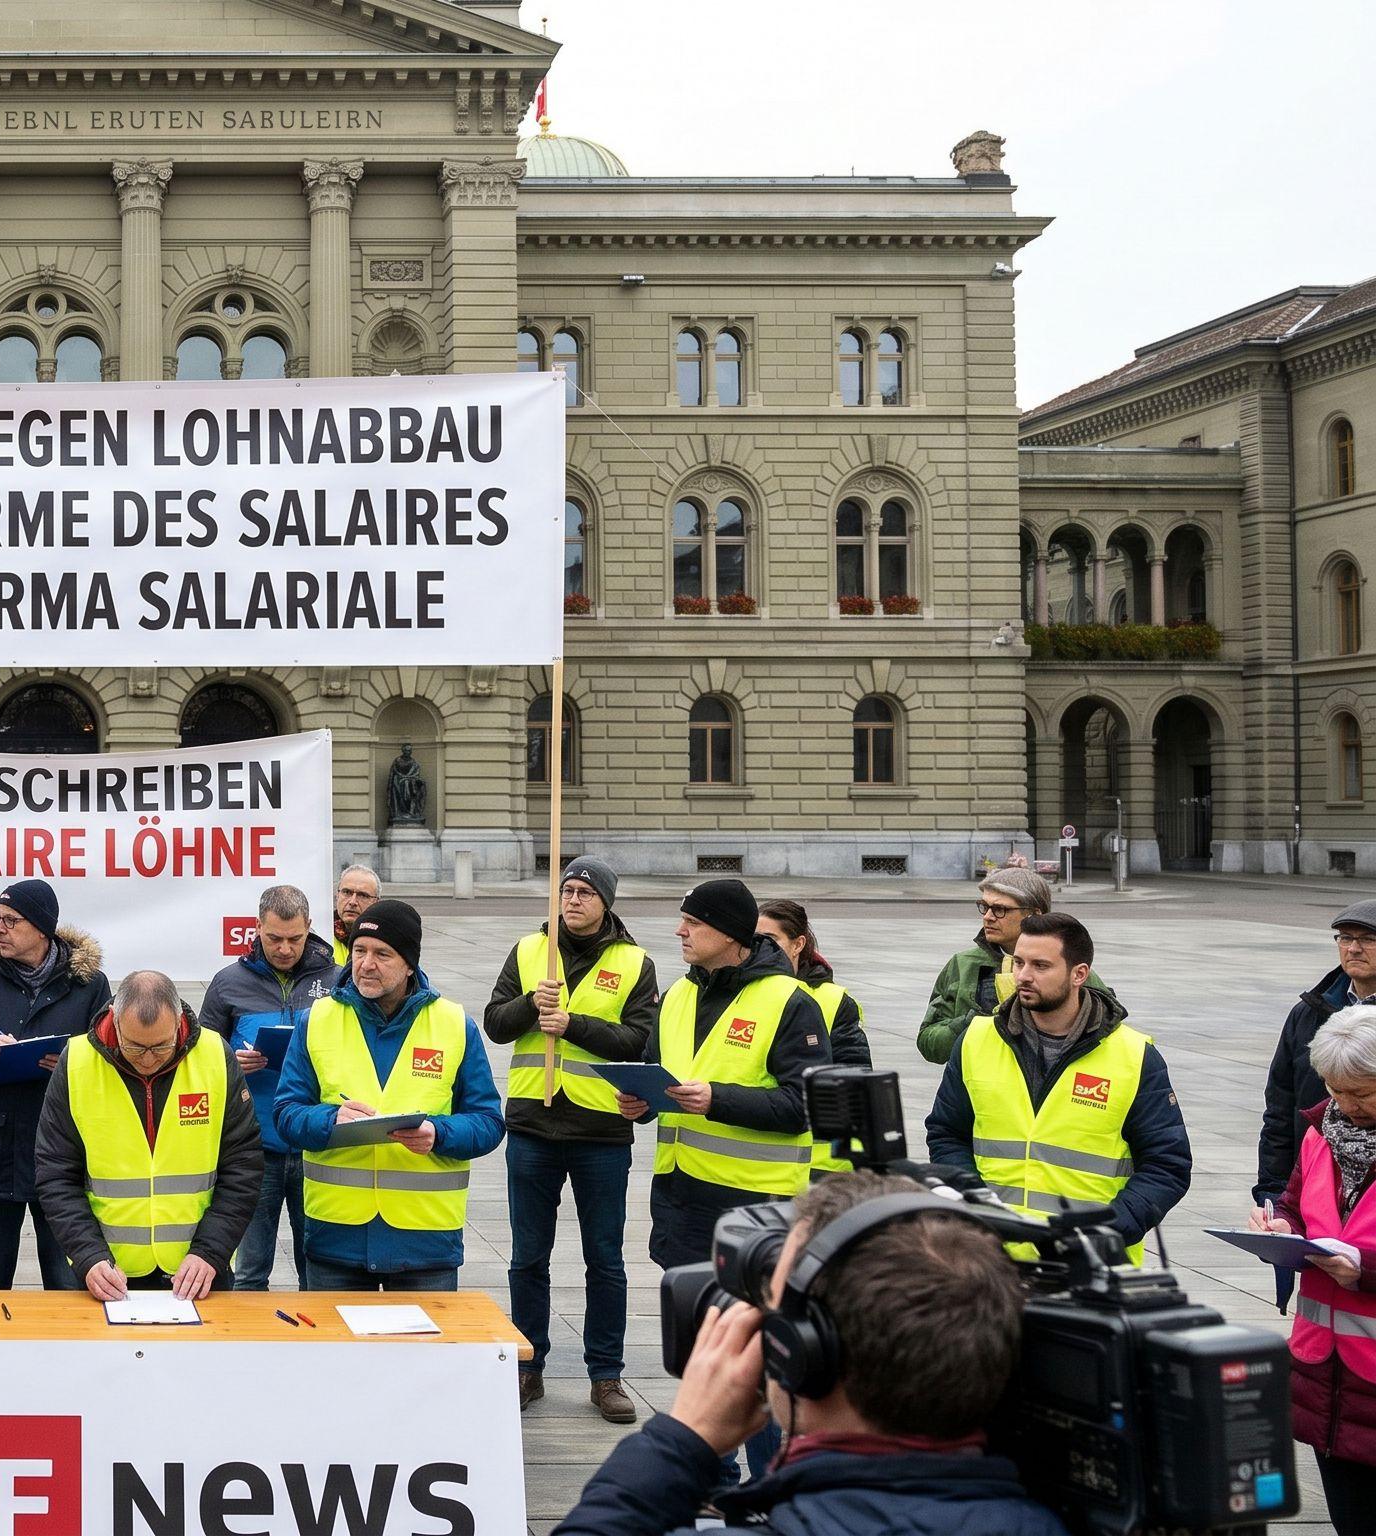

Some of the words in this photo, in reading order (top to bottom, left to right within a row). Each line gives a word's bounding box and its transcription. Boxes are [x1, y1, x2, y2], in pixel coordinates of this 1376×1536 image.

[90, 110, 204, 130] ERUTEN
[154, 406, 501, 466] LOHNABBAU
[114, 490, 218, 547] DES
[239, 488, 508, 547] SALAIRES
[139, 571, 444, 630] SALARIALE
[105, 815, 276, 878] LÖHNE
[230, 927, 257, 946] SR
